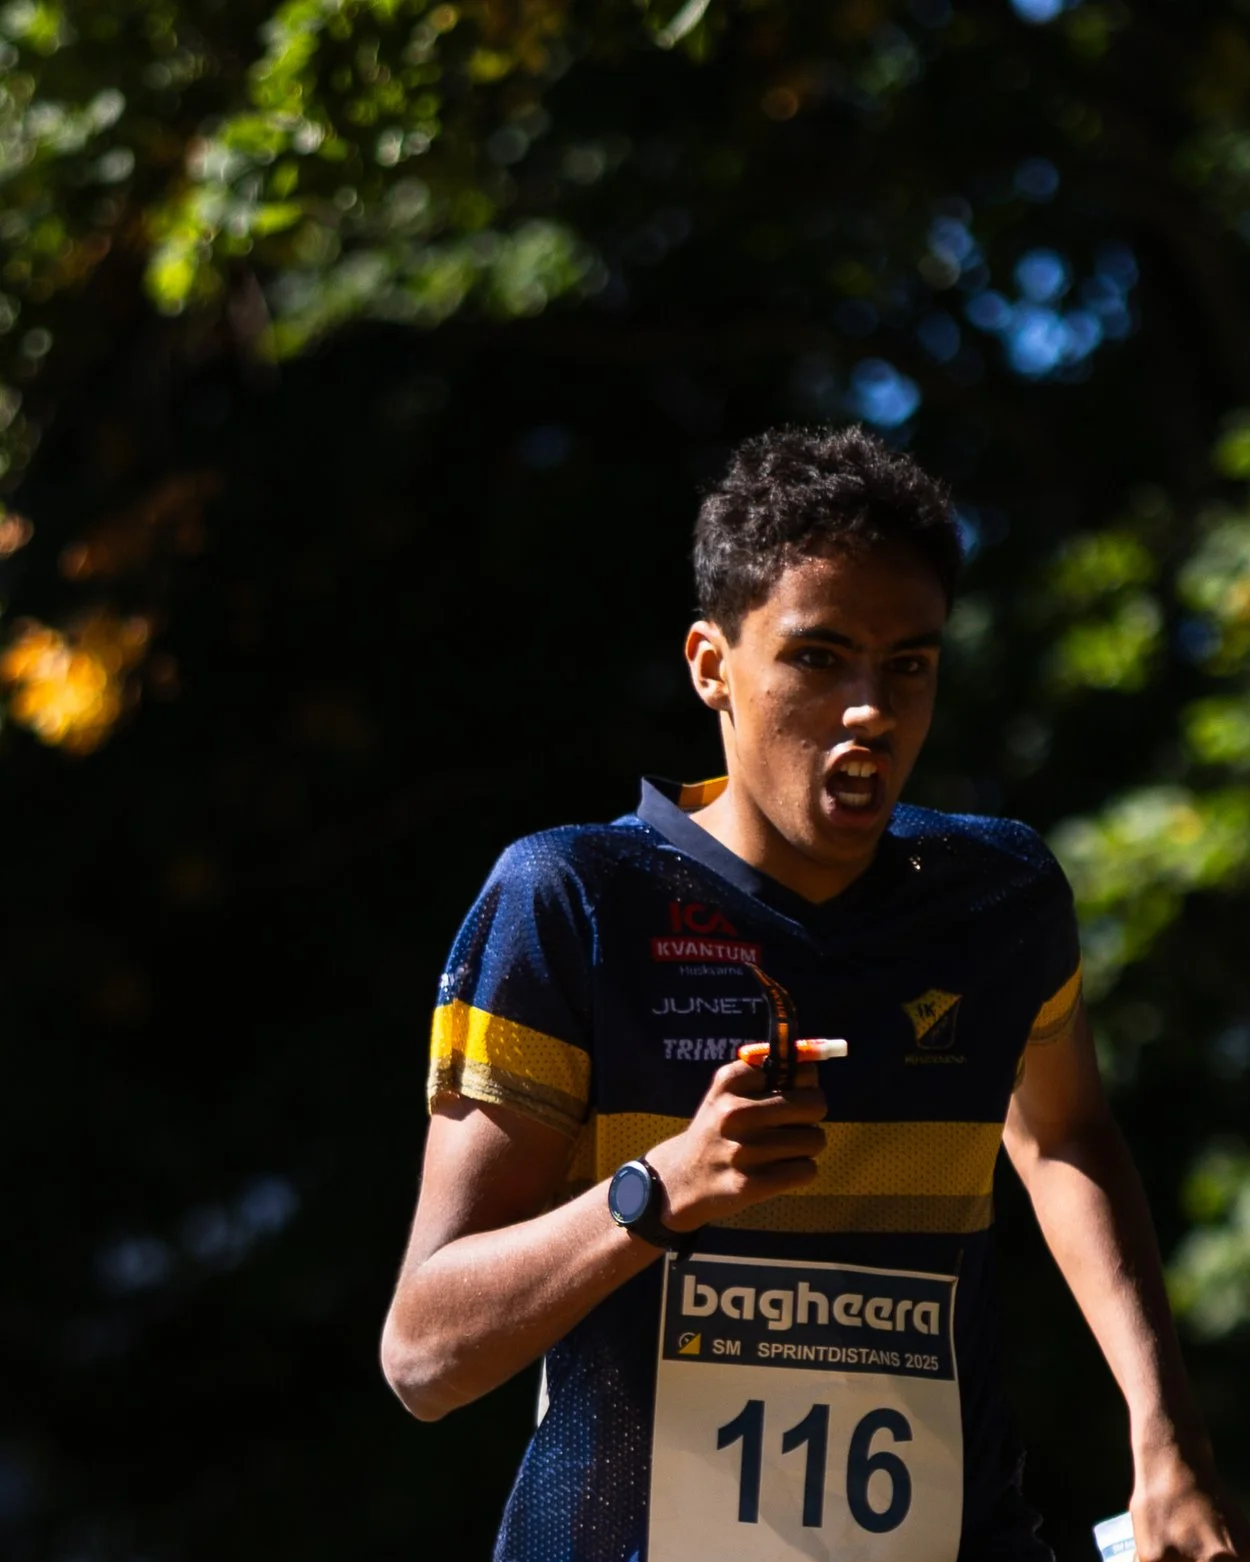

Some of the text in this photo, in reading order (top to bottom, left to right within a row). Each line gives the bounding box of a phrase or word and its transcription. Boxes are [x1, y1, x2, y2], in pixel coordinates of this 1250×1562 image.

[668, 900, 739, 936] ICA
[656, 940, 757, 963] KVANTUM
[652, 996, 763, 1015] JUNET
[662, 1037, 757, 1061] TRIMT
[682, 1275, 940, 1336] bagheera
[712, 1339, 939, 1372] SM SPRINTDISTANS 2025
[716, 1399, 914, 1534] 116
